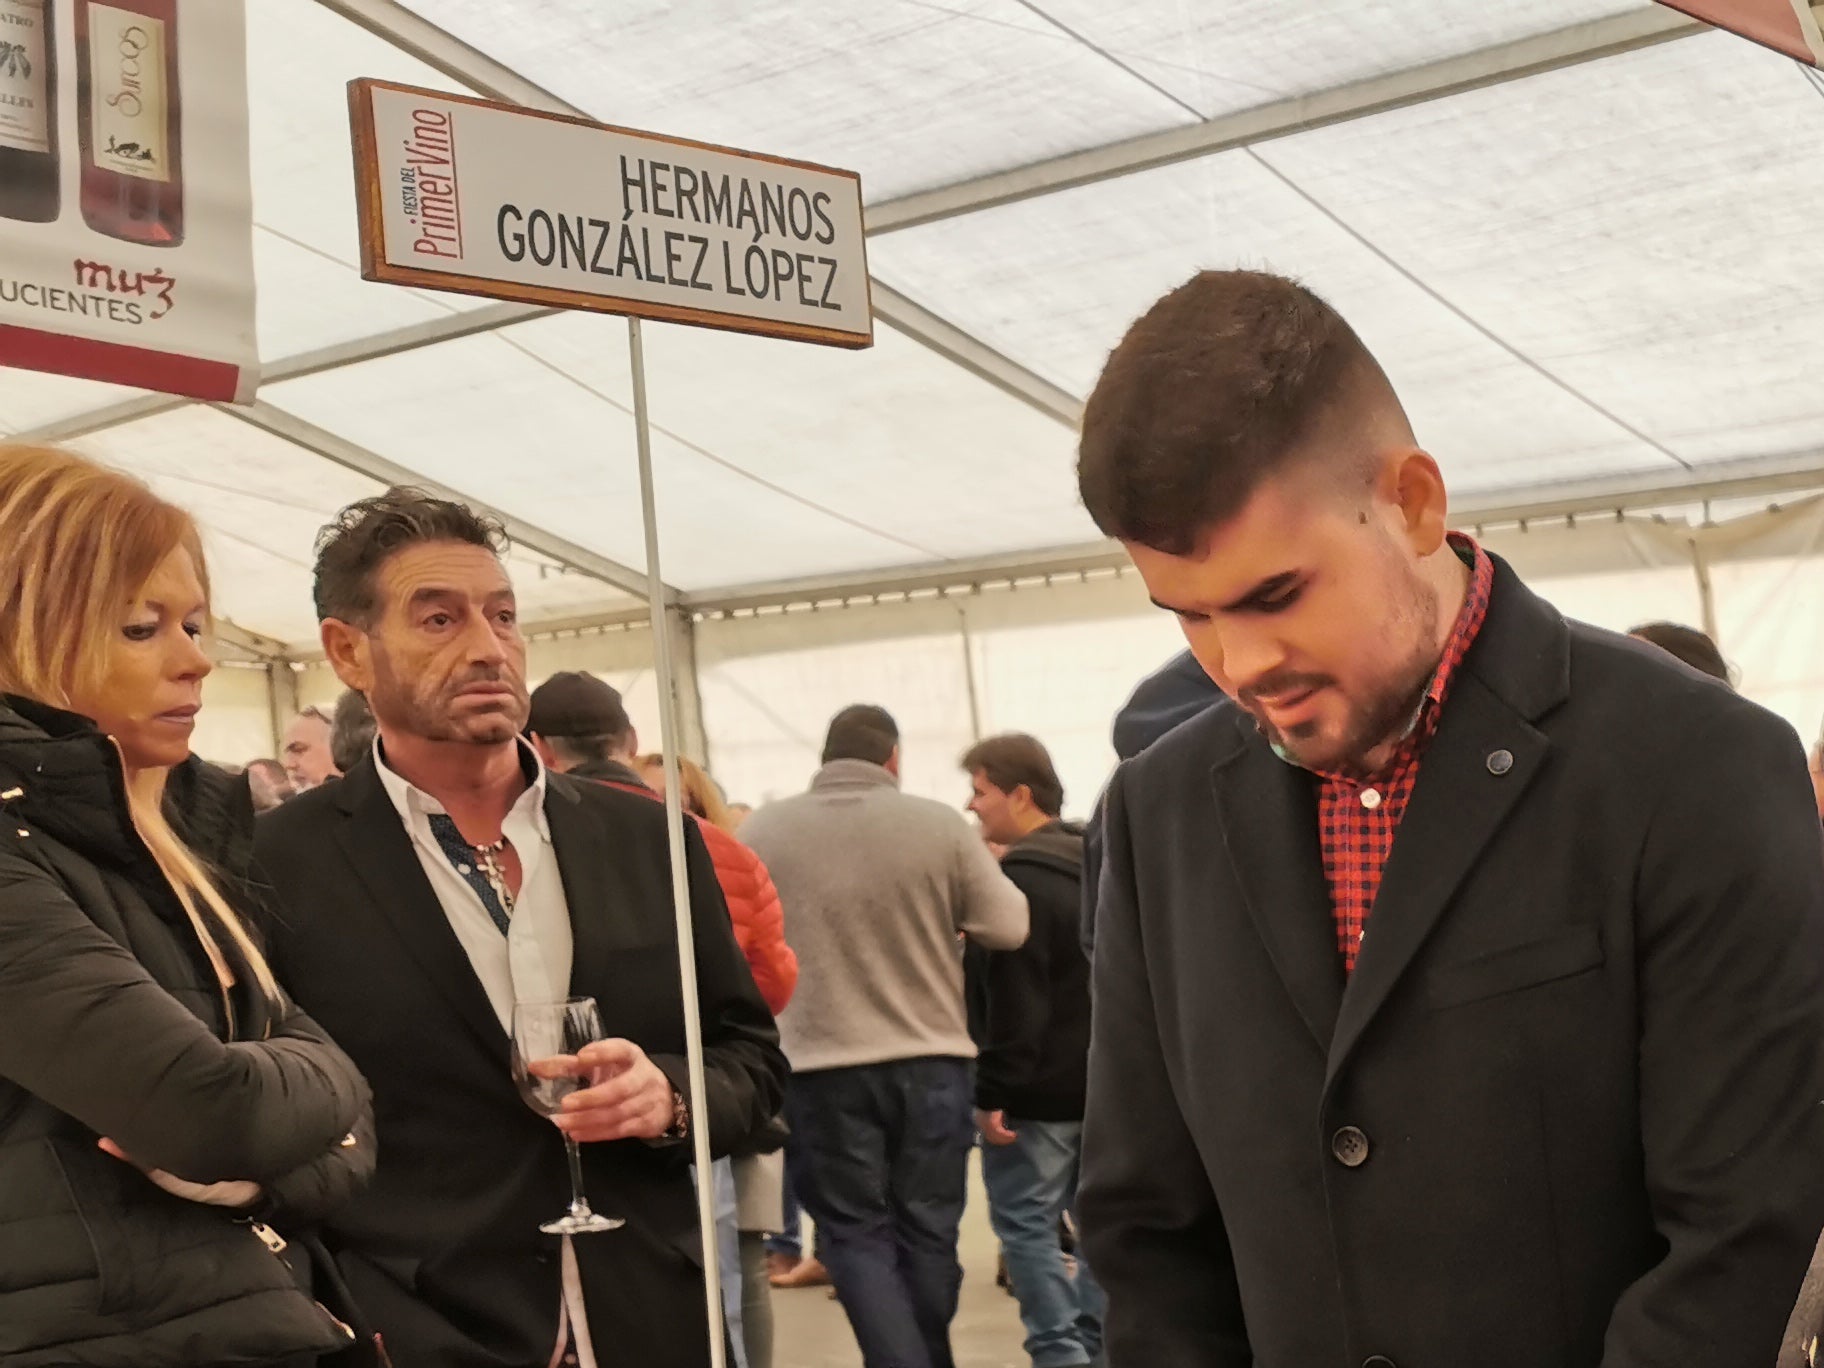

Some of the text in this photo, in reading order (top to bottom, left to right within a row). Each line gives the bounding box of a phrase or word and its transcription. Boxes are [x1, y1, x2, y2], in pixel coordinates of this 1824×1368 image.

[401, 167, 418, 216] FIESTA DEL
[619, 154, 835, 245] HERMANOS
[498, 203, 842, 312] GONZÁLEZ LÓPEZ
[0, 279, 143, 325] UCIENTES
